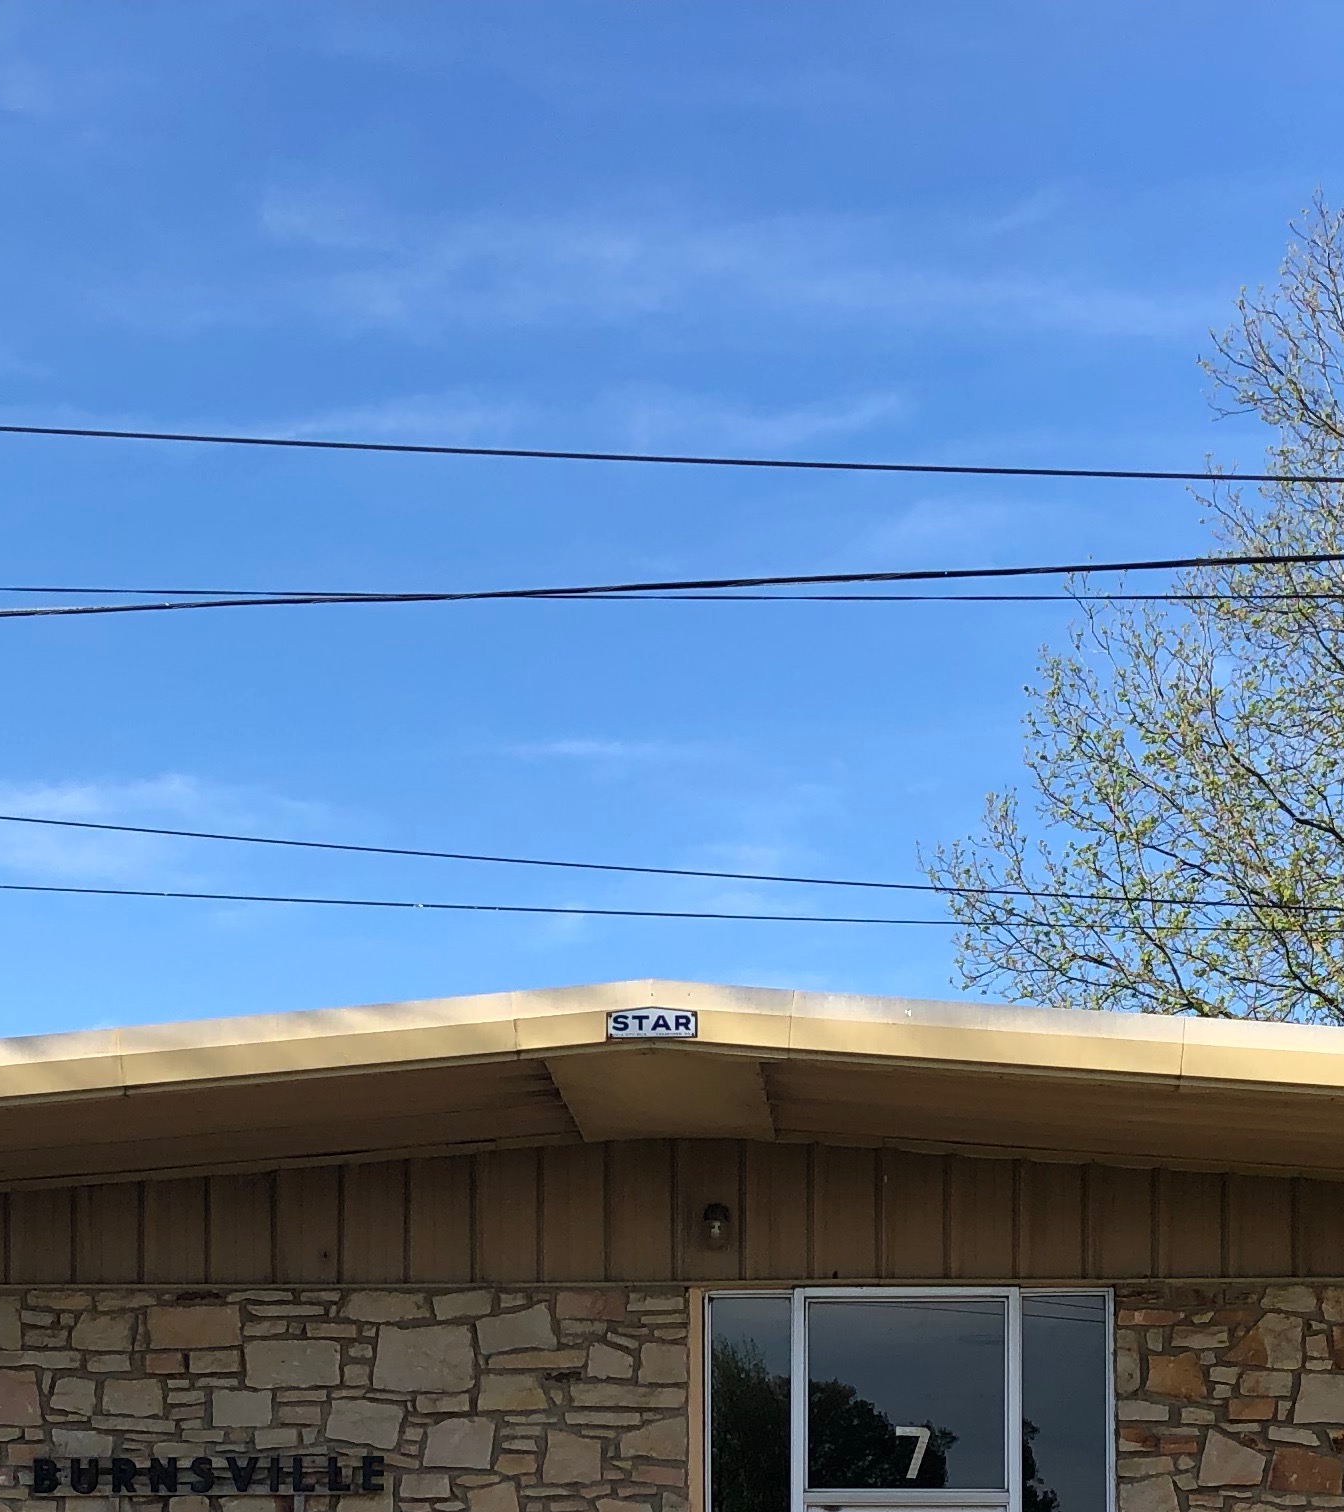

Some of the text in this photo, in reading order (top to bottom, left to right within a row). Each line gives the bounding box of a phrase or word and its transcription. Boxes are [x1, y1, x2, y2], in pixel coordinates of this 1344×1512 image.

[611, 1014, 692, 1032] STAR
[895, 1425, 931, 1479] 7
[33, 1455, 385, 1494] BURNSVILLE
